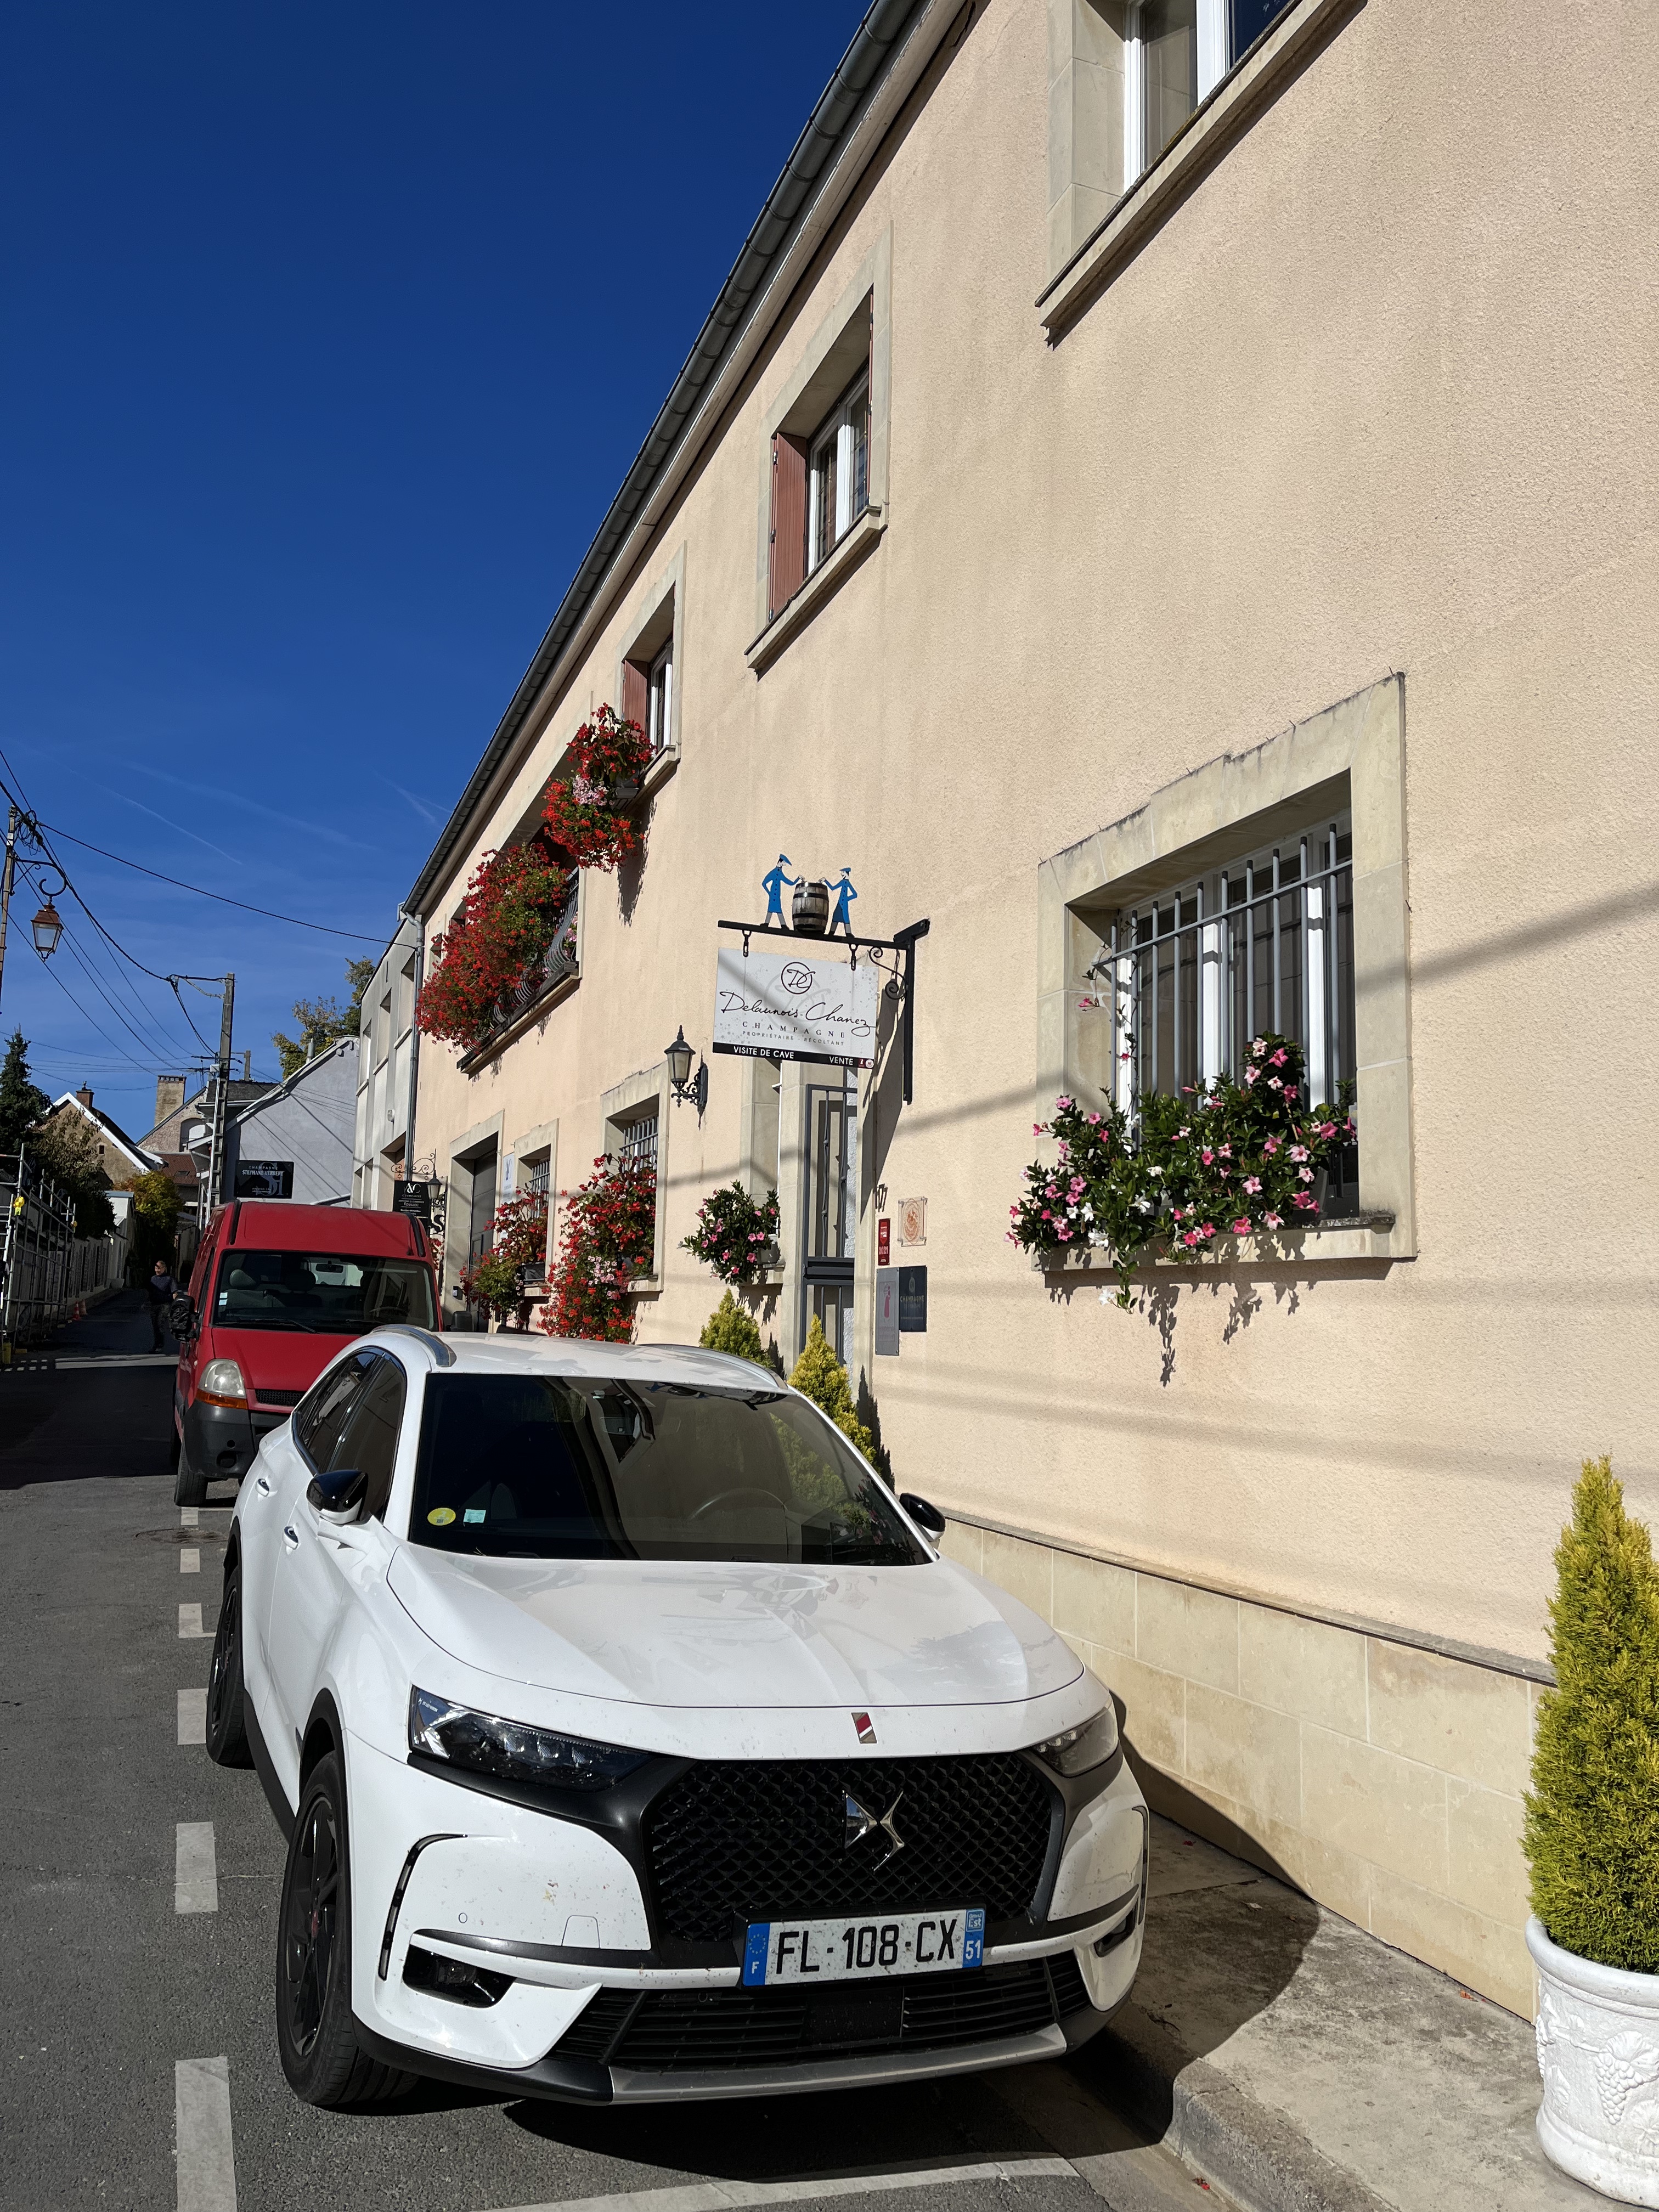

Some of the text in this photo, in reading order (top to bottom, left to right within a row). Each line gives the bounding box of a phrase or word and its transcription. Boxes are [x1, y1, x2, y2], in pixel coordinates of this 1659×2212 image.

[742, 1022, 845, 1038] CHAMPAGNE
[742, 1031, 794, 1041] PROPRIÉTAIRE
[804, 1037, 844, 1046] RÉCOLTANT
[733, 1046, 758, 1056] VISITE
[773, 1051, 794, 1059] CAVE
[829, 1056, 854, 1065] VENTE
[965, 1939, 981, 1960] 51
[751, 1961, 758, 1974] F
